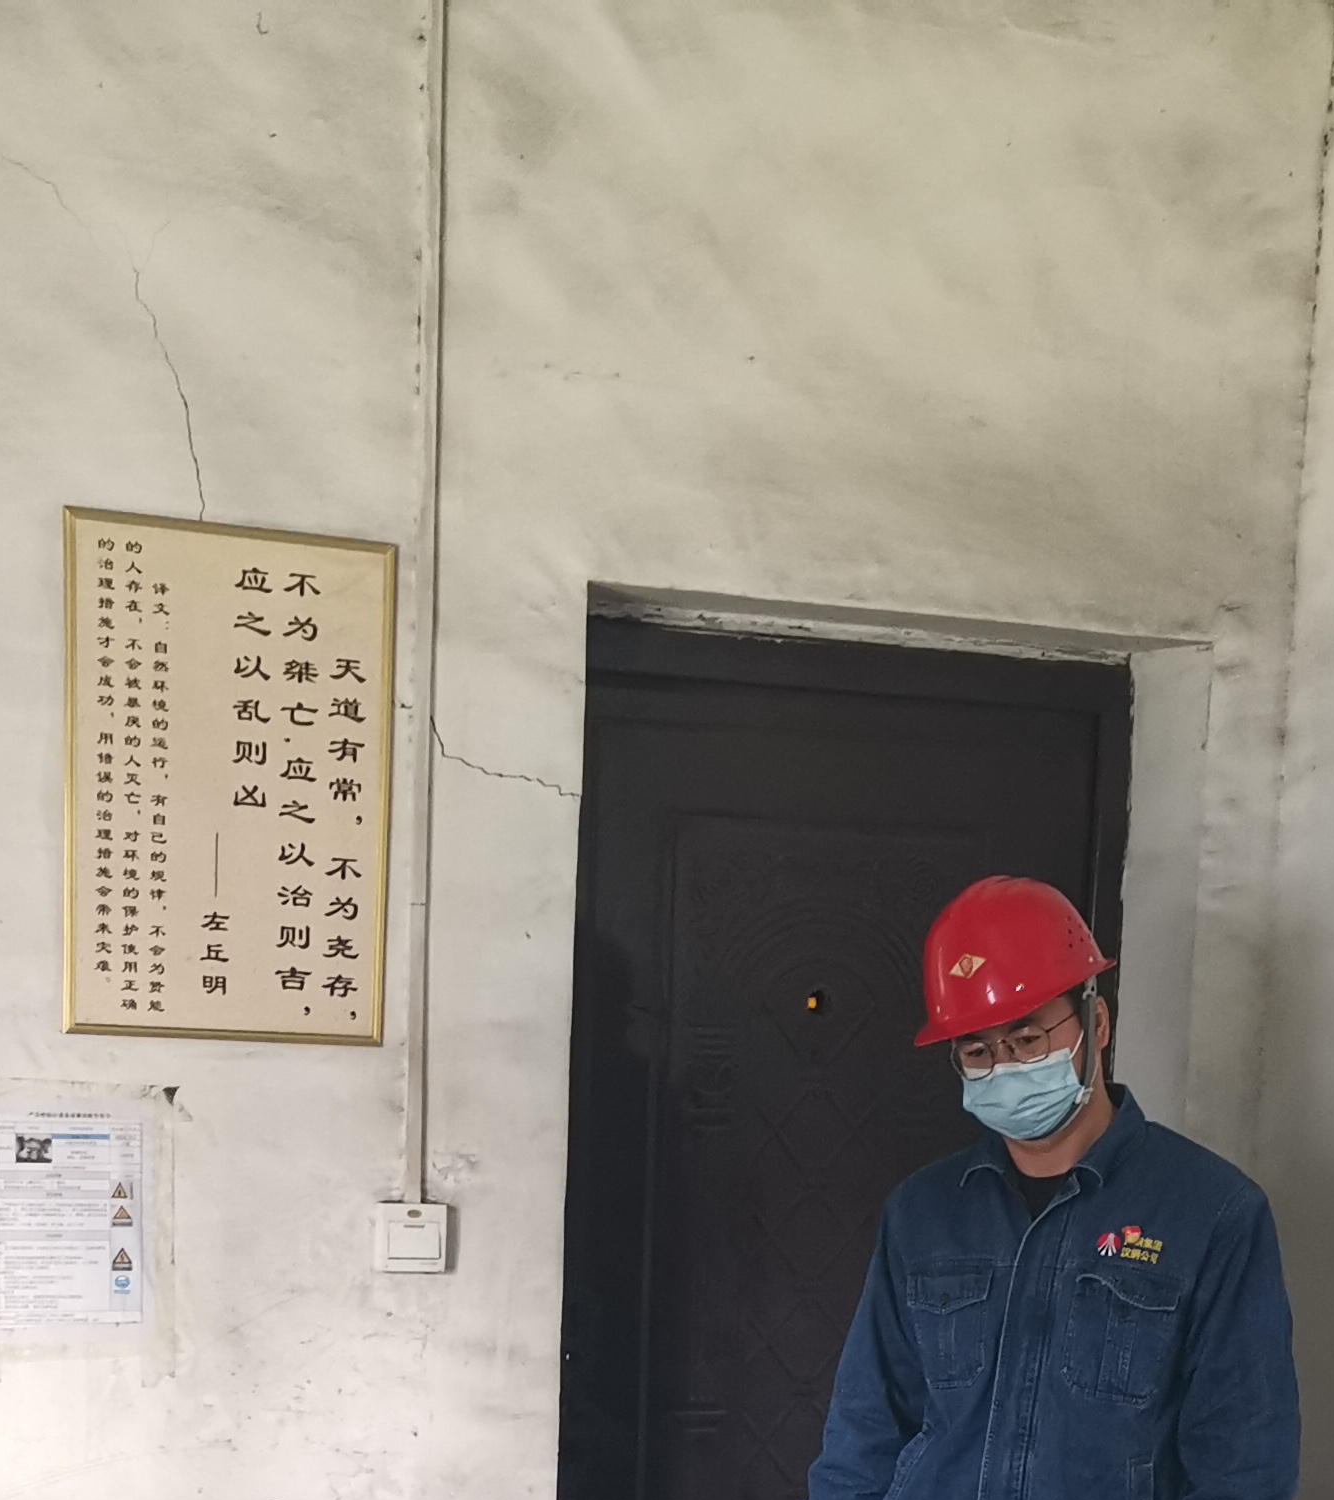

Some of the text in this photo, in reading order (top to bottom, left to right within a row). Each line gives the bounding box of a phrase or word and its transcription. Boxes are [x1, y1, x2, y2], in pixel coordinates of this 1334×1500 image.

[231, 567, 273, 808] 应之以乱则凶
